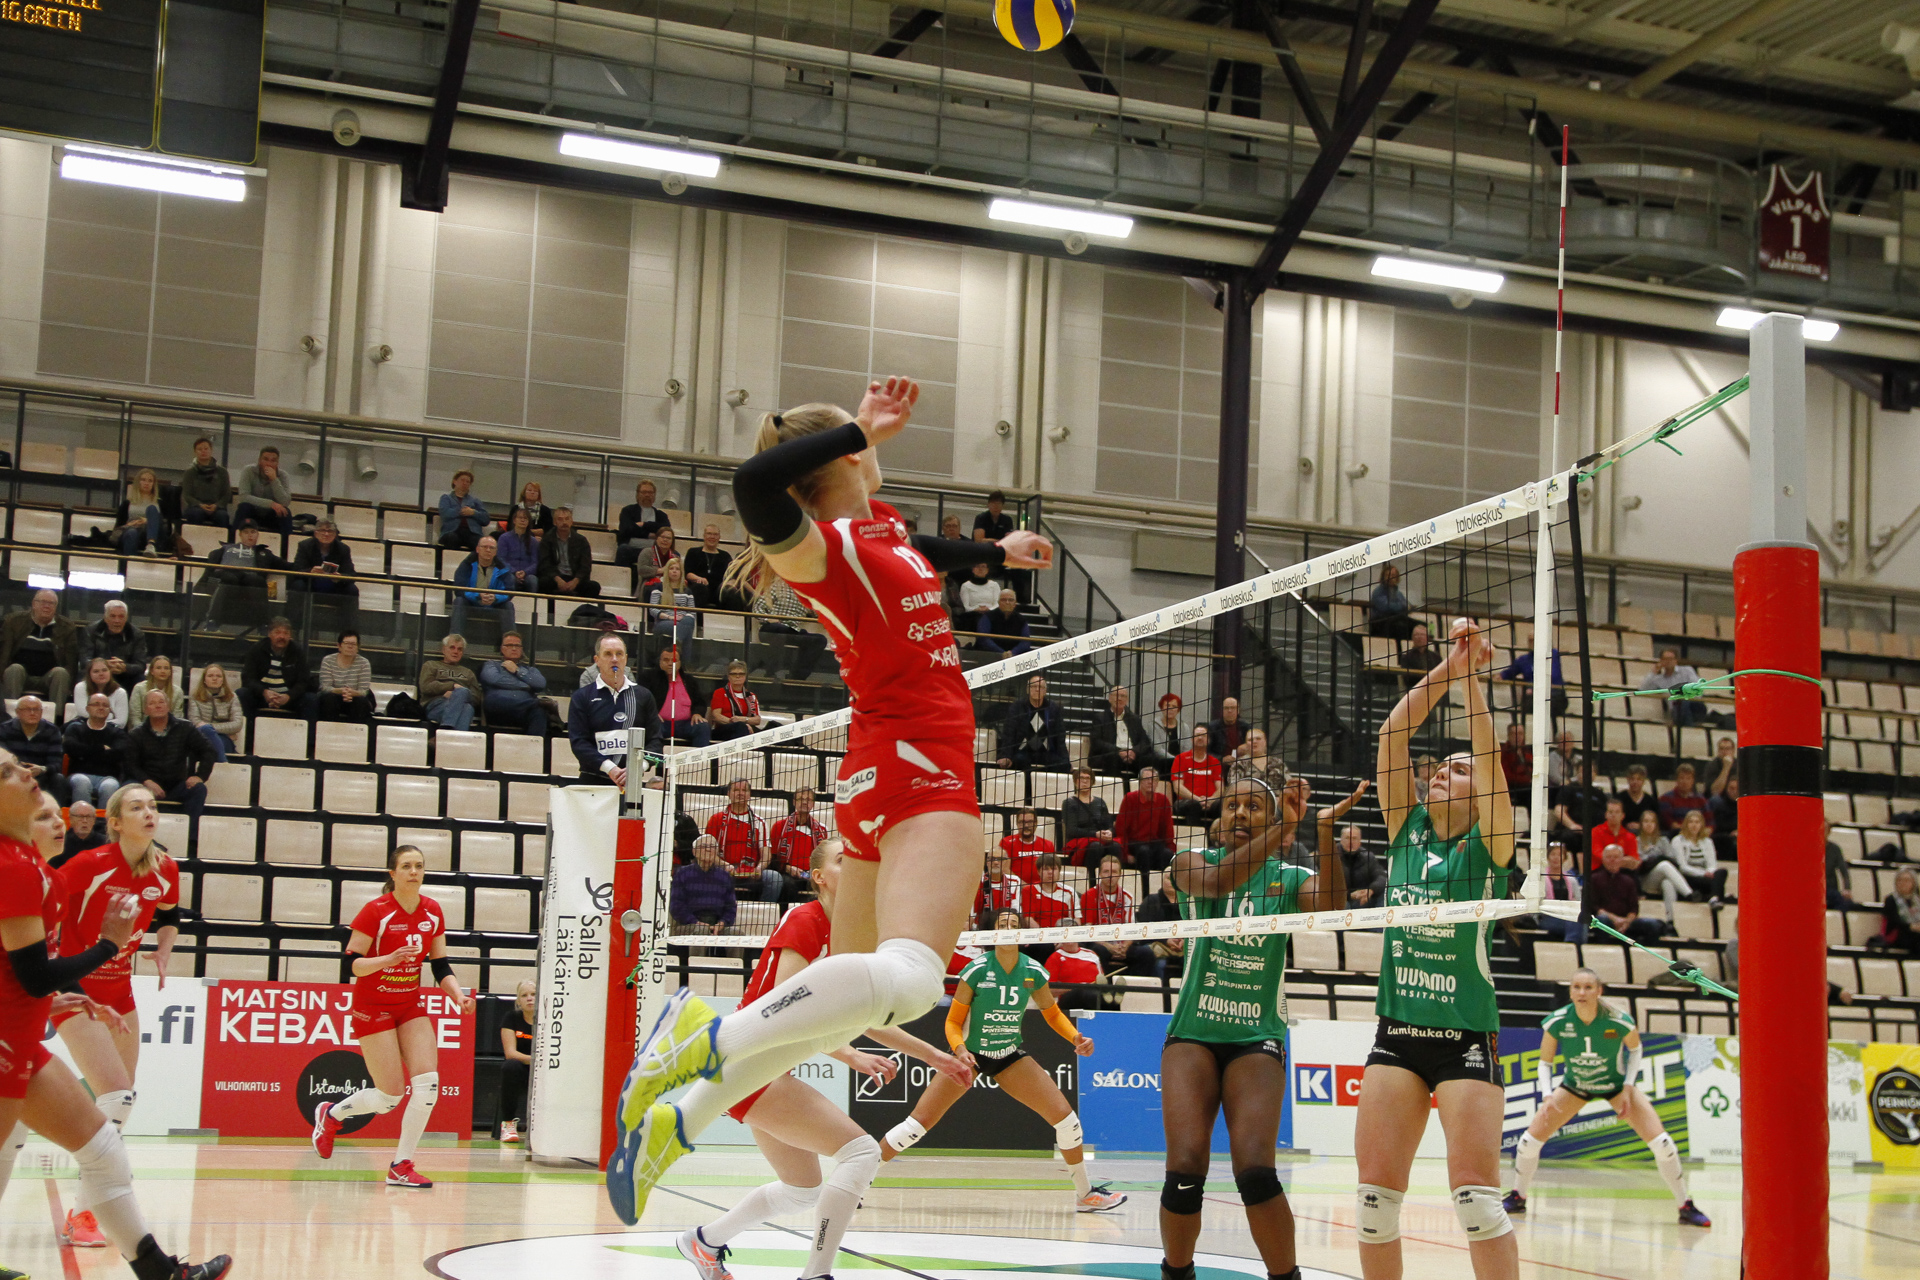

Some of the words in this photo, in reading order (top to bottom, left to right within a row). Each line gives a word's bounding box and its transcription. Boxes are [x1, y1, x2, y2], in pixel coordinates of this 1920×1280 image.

[24, 4, 82, 32] GREEN
[1790, 215, 1801, 249] 1
[1456, 507, 1503, 533] talokeskus
[1388, 530, 1431, 556] talokeskus
[892, 546, 934, 579] 12
[1327, 553, 1366, 575] talokeskus
[1272, 572, 1307, 593] talokeskus
[598, 738, 628, 751] Dele
[1420, 850, 1444, 881] 7
[405, 933, 423, 954] 13
[577, 915, 602, 980] Sallab
[1407, 946, 1444, 961] EOPINTA
[221, 987, 327, 1010] MATSIN
[548, 915, 576, 1070] Lääkäriasema
[999, 985, 1019, 1006] 15
[1198, 993, 1261, 1019] KUUSAMO
[1196, 1011, 1261, 1027] HIRSITALOT
[1445, 1029, 1462, 1041] Oy
[215, 1081, 268, 1092] VILHONKATU
[270, 1082, 281, 1092] 15
[441, 1086, 460, 1096] 523
[1092, 1071, 1161, 1091] SALON
[1300, 1069, 1330, 1099] K
[1562, 1117, 1617, 1135] TREENEIHIN
